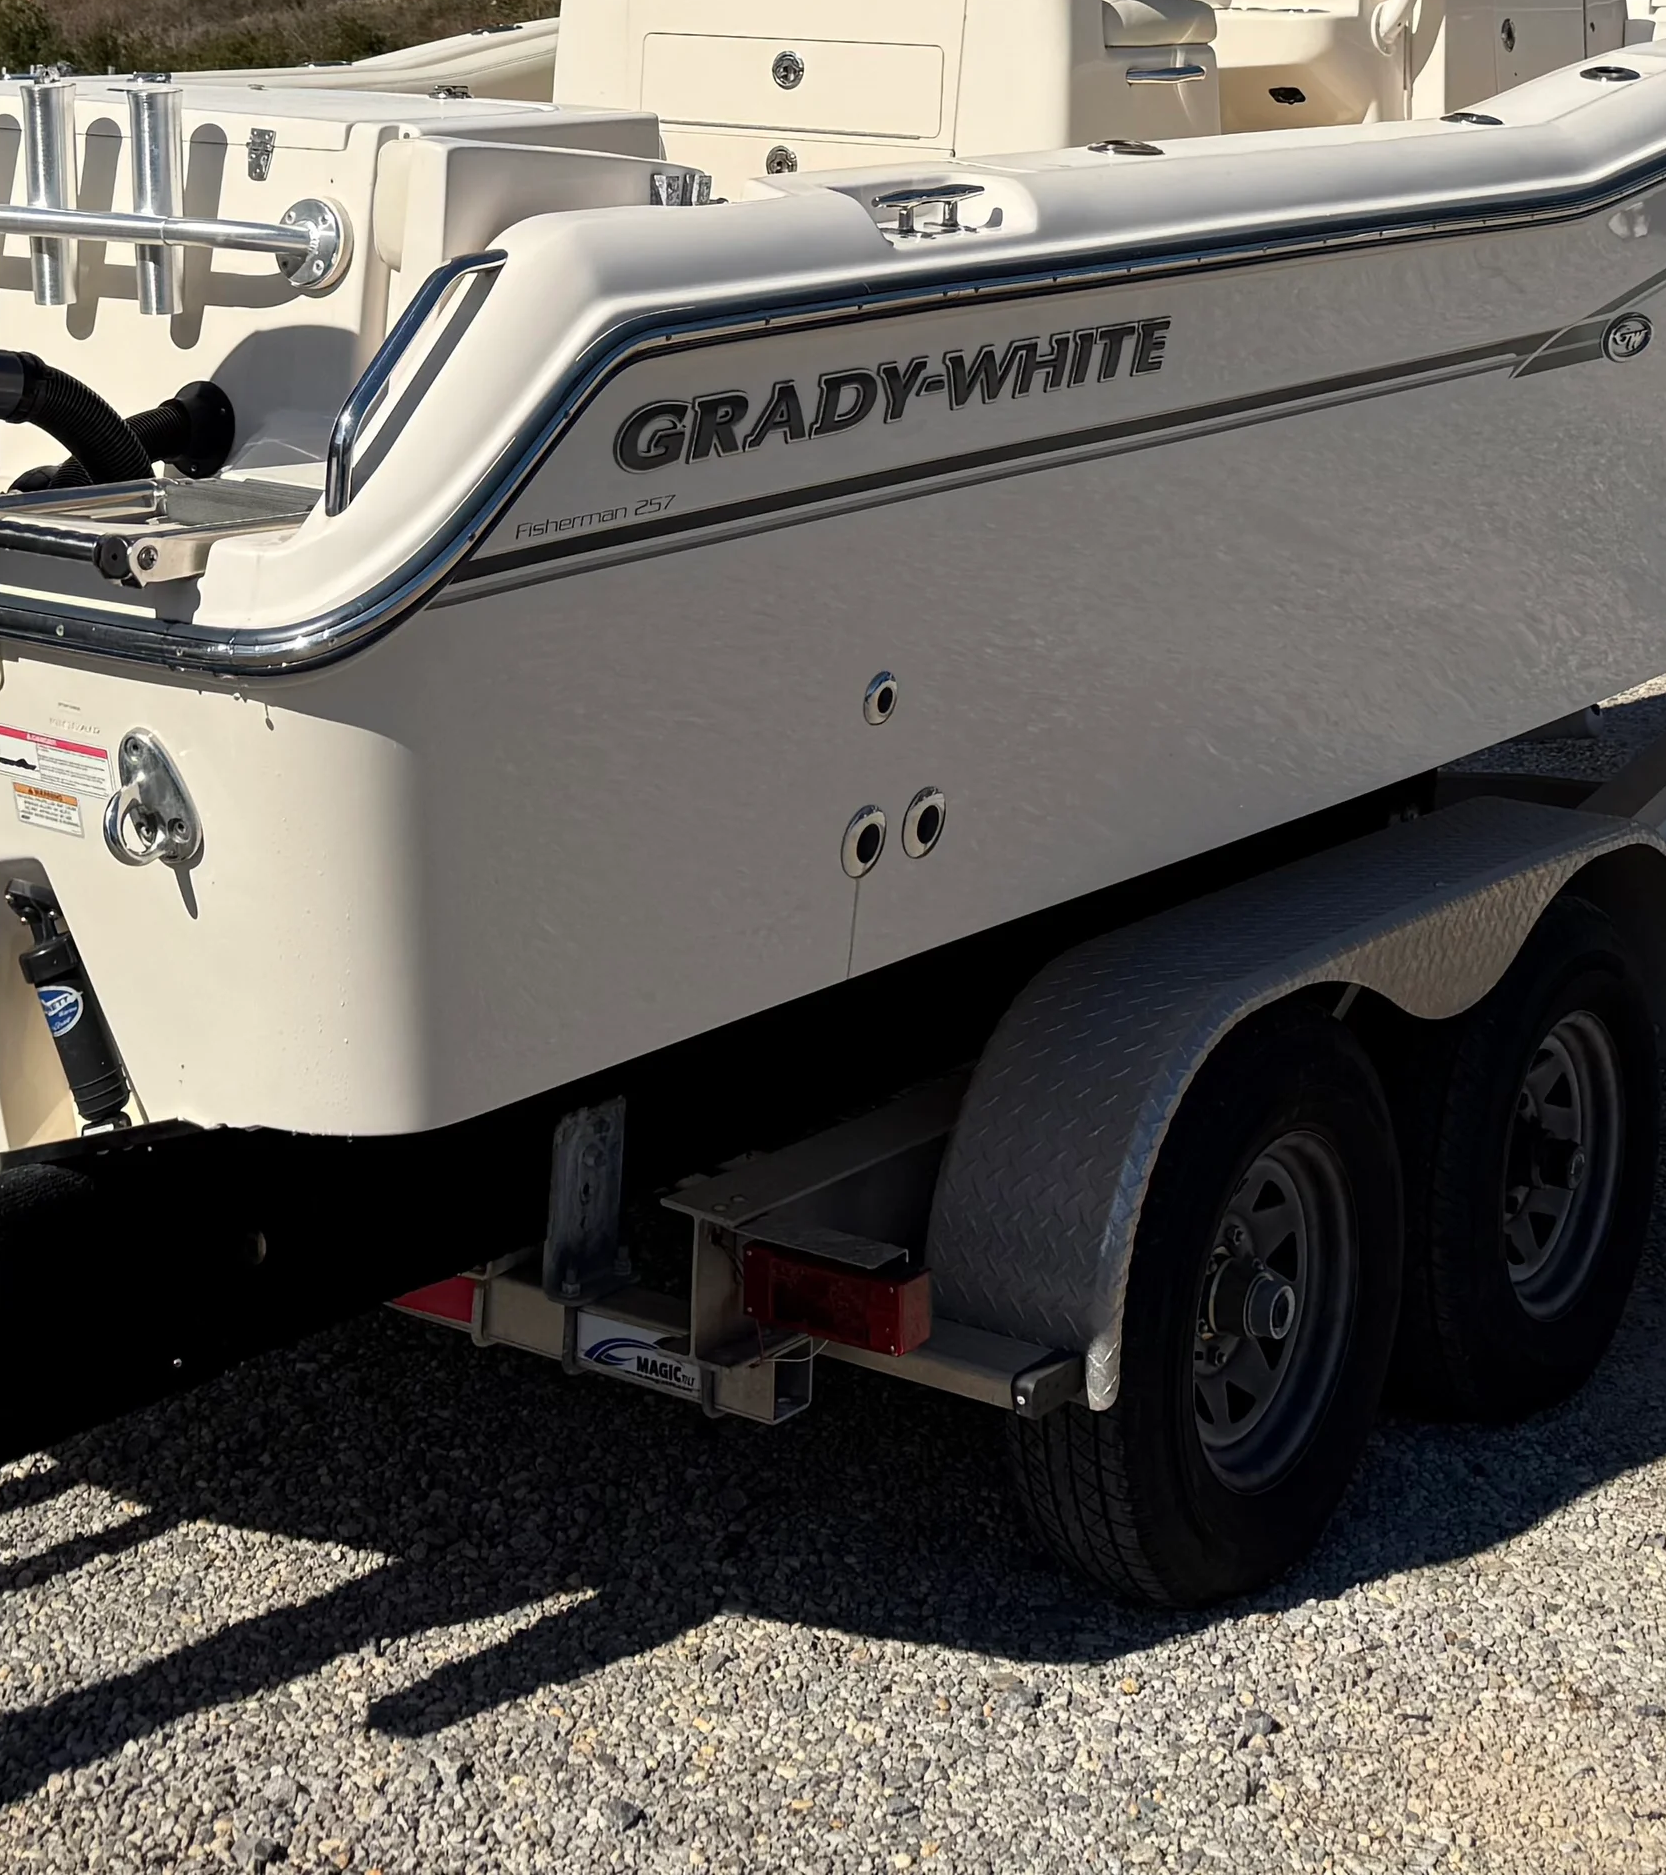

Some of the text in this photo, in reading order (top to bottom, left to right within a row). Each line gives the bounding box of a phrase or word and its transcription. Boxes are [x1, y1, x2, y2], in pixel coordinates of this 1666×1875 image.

[612, 316, 1172, 474] GRADY-WHITE
[515, 494, 677, 540] Fisherman 257
[636, 1355, 682, 1383] MAGIC
